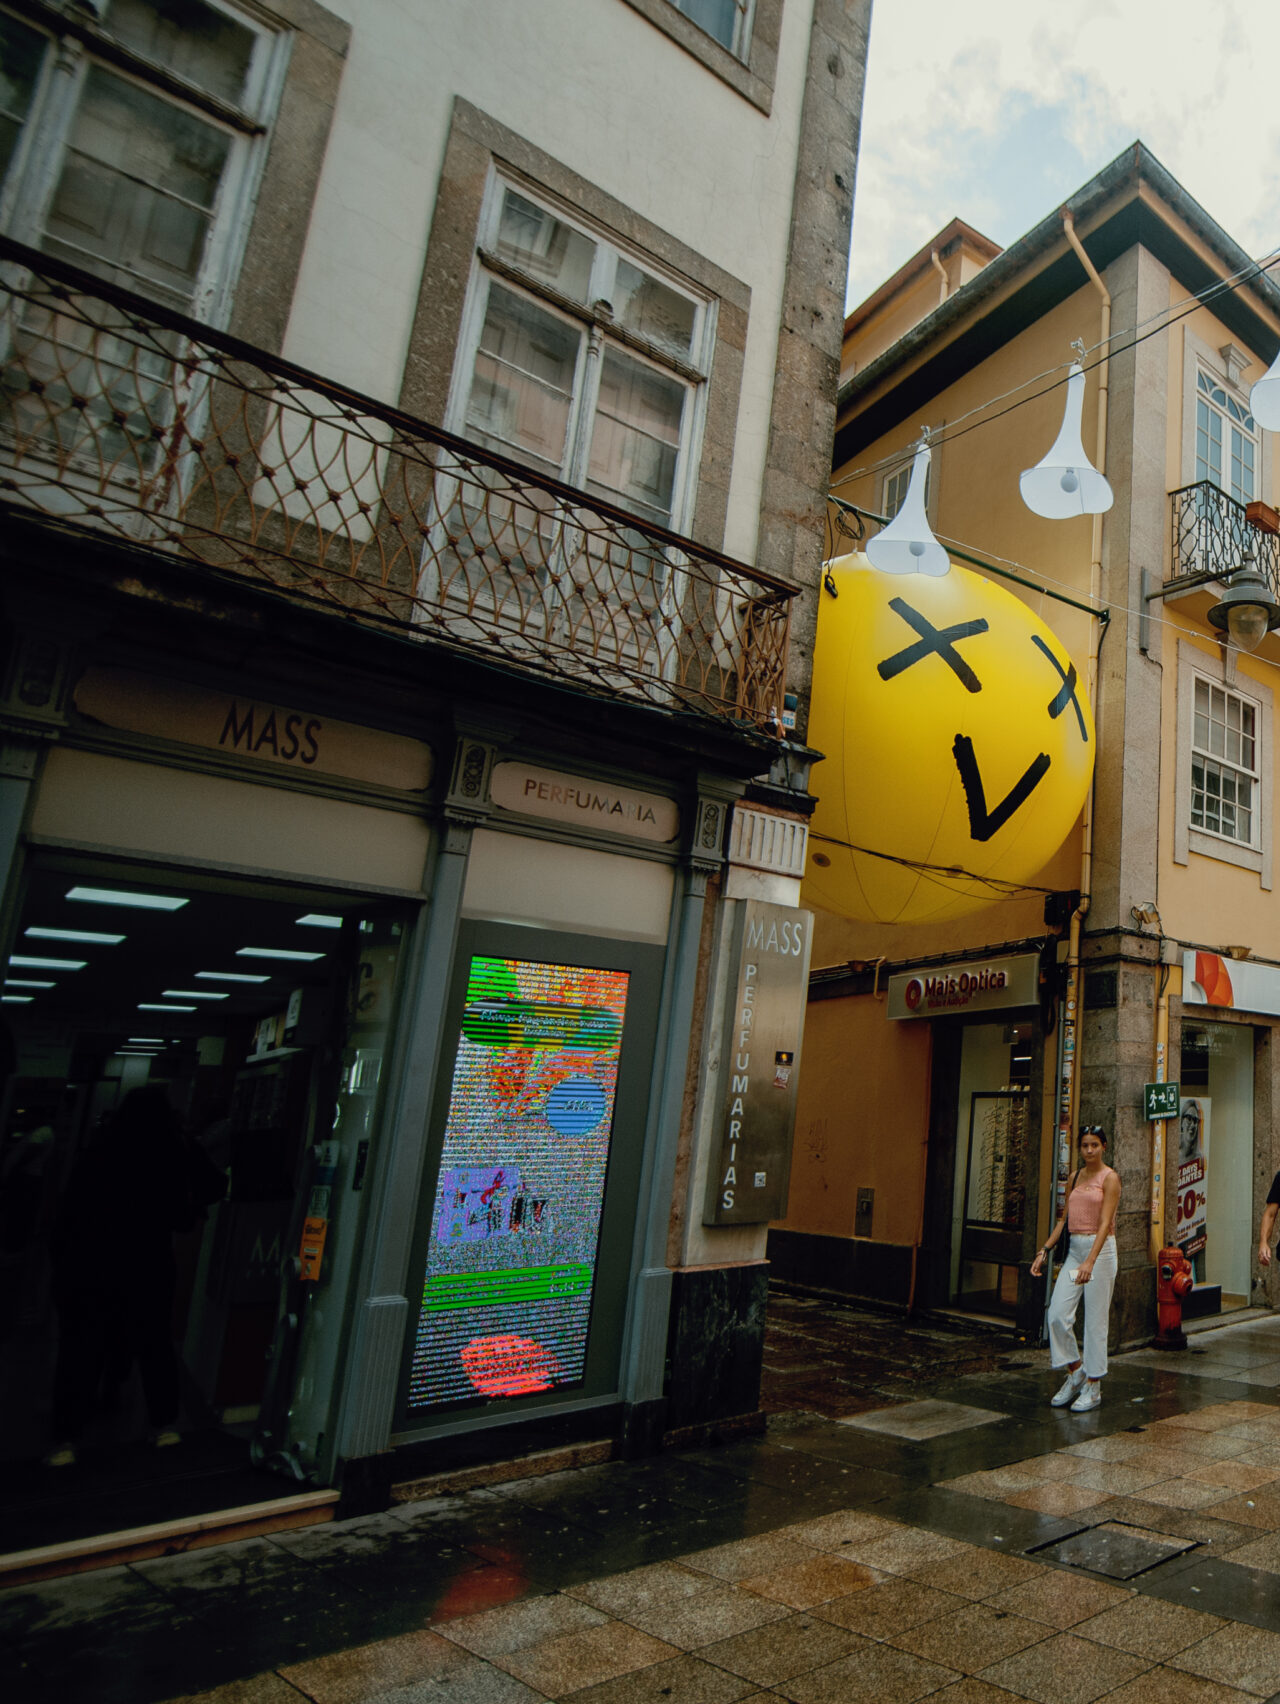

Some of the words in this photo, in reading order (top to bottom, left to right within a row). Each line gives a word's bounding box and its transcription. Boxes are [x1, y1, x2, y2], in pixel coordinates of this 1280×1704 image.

[219, 699, 322, 764] MASS
[745, 918, 804, 957] MASS
[925, 975, 956, 997] Mais
[958, 968, 1005, 998] Optica
[722, 963, 757, 1209] PERFUMARIAS
